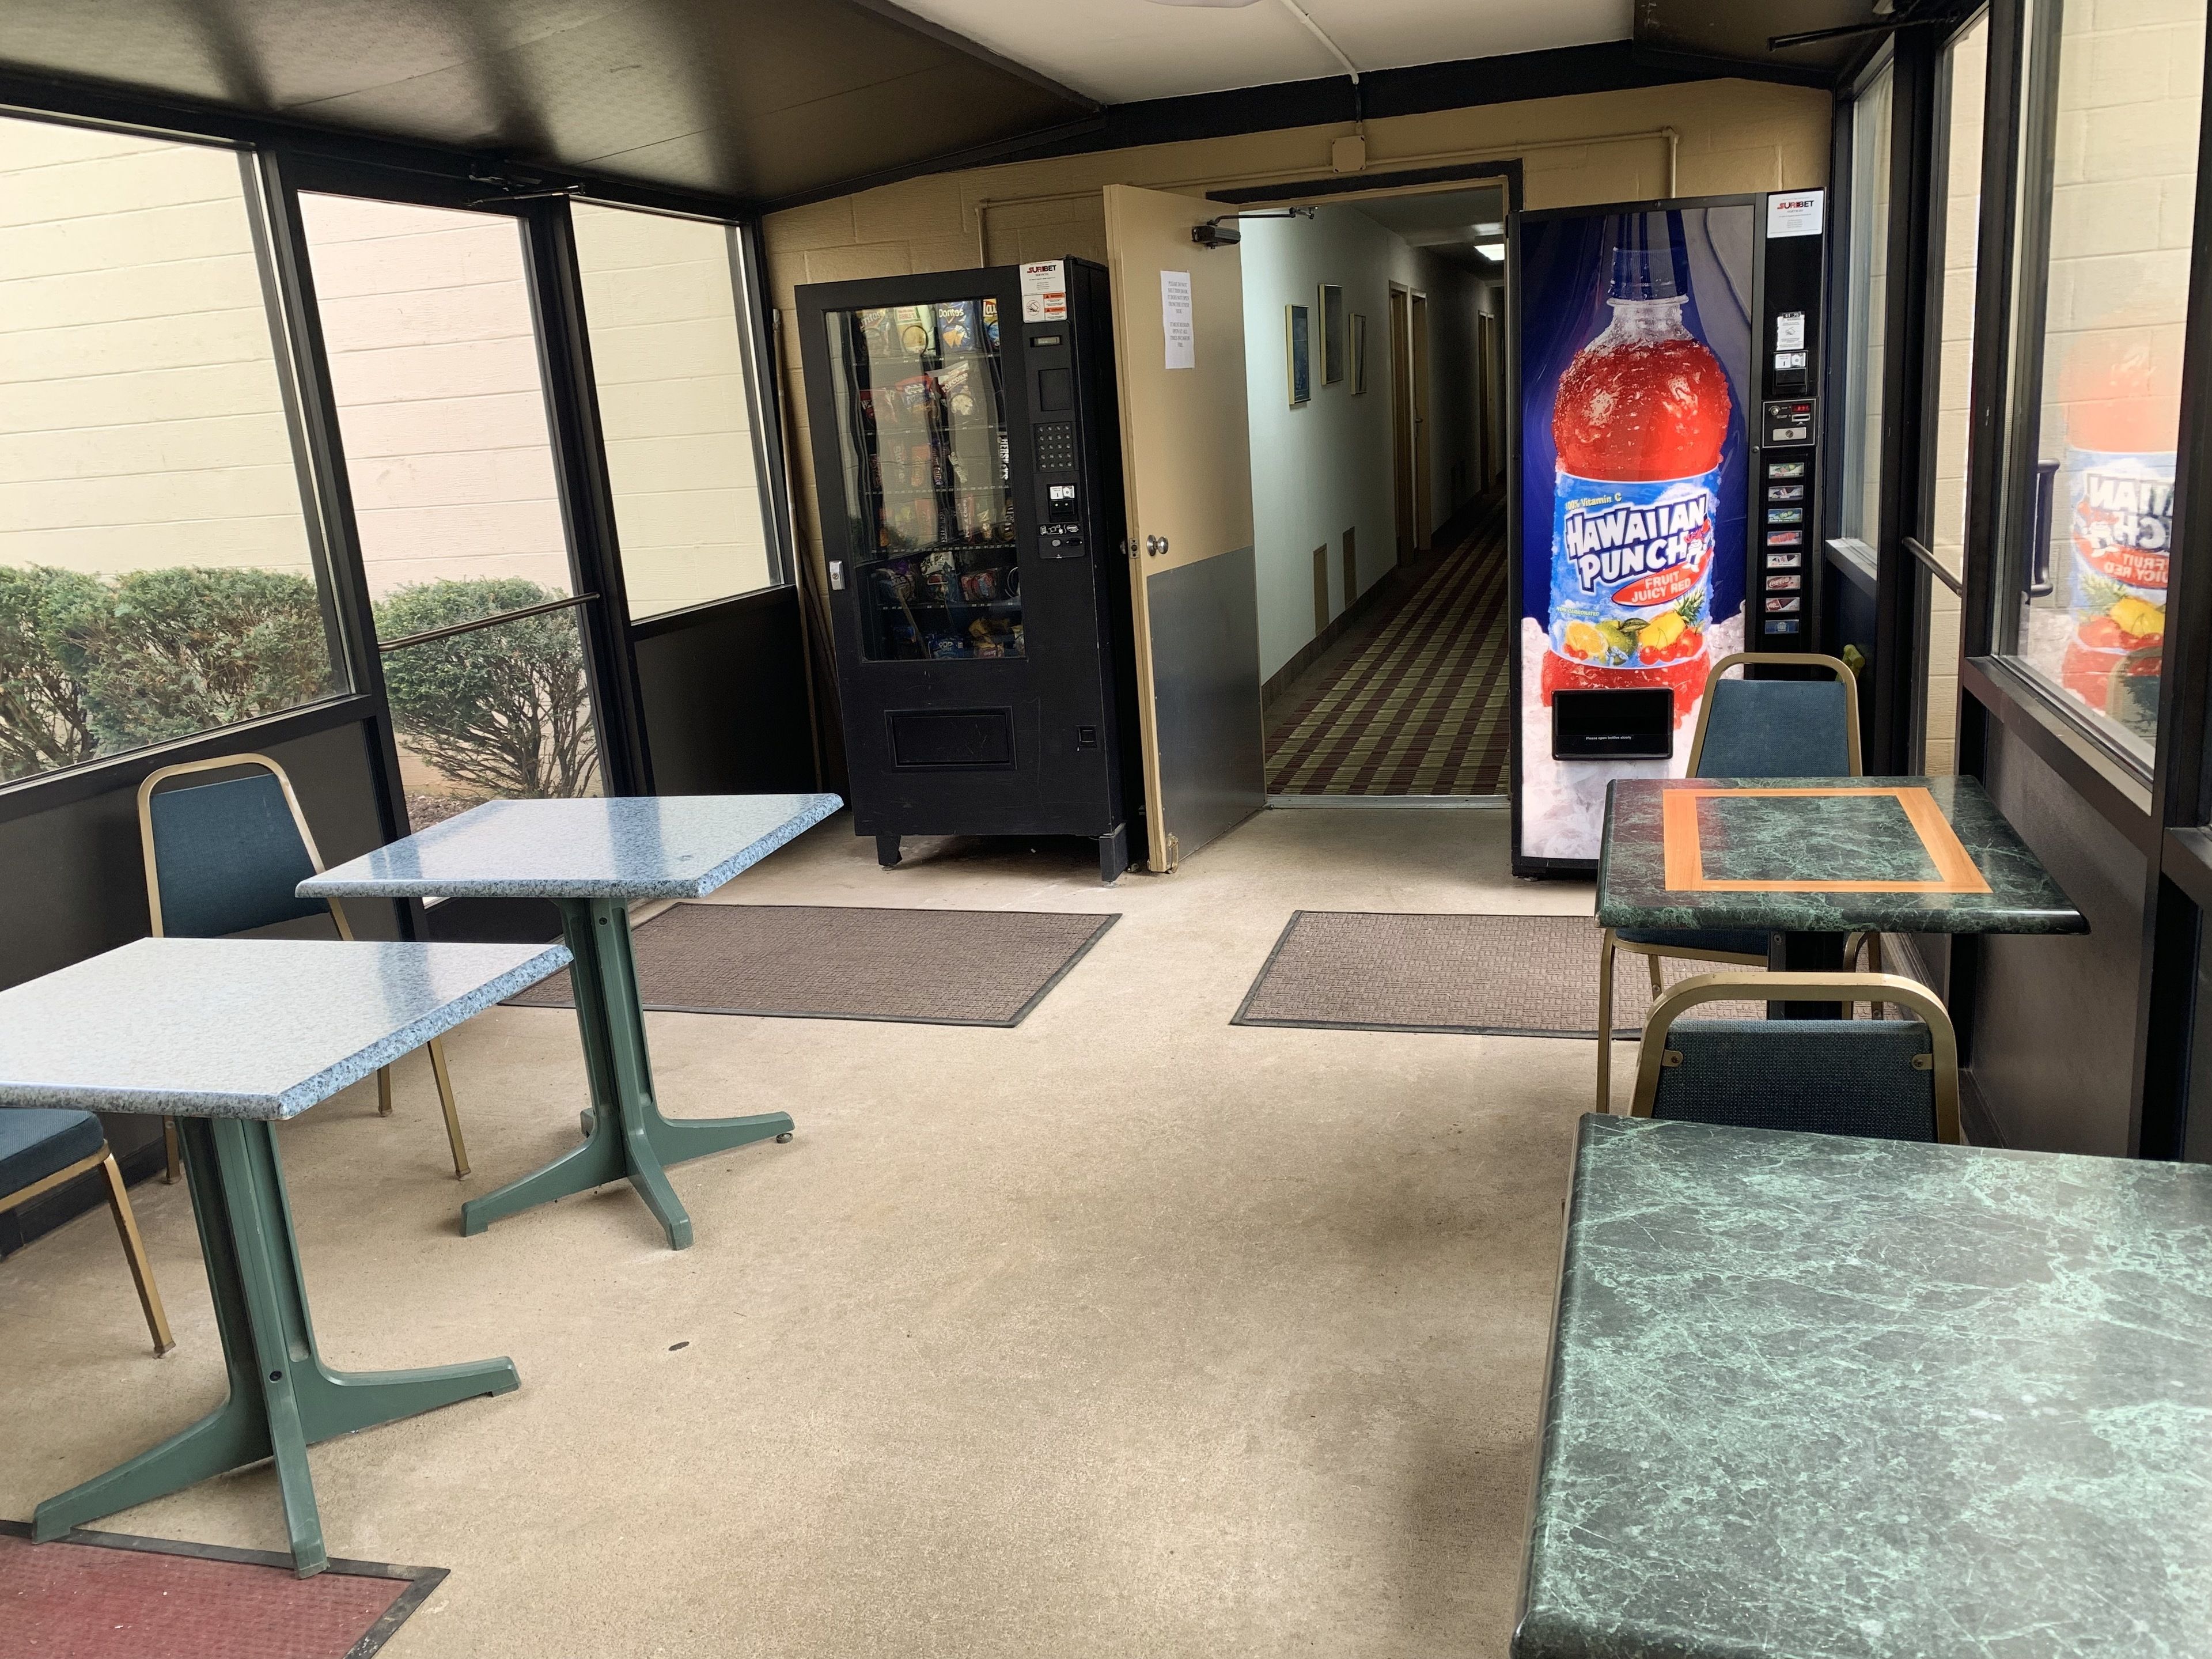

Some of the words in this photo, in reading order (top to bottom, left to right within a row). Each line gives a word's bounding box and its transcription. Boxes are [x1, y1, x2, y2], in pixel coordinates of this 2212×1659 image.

[938, 308, 964, 318] Doritos
[942, 372, 968, 393] POPCORN
[1565, 499, 1580, 511] 100%
[1581, 496, 1612, 507] Vitamin
[1615, 493, 1622, 502] C
[1566, 497, 1706, 558] HAWAIIAN
[1579, 531, 1690, 589] PUNCH
[1645, 570, 1680, 590] FRUIT
[1631, 584, 1666, 604] JUICY
[1671, 578, 1692, 594] RED
